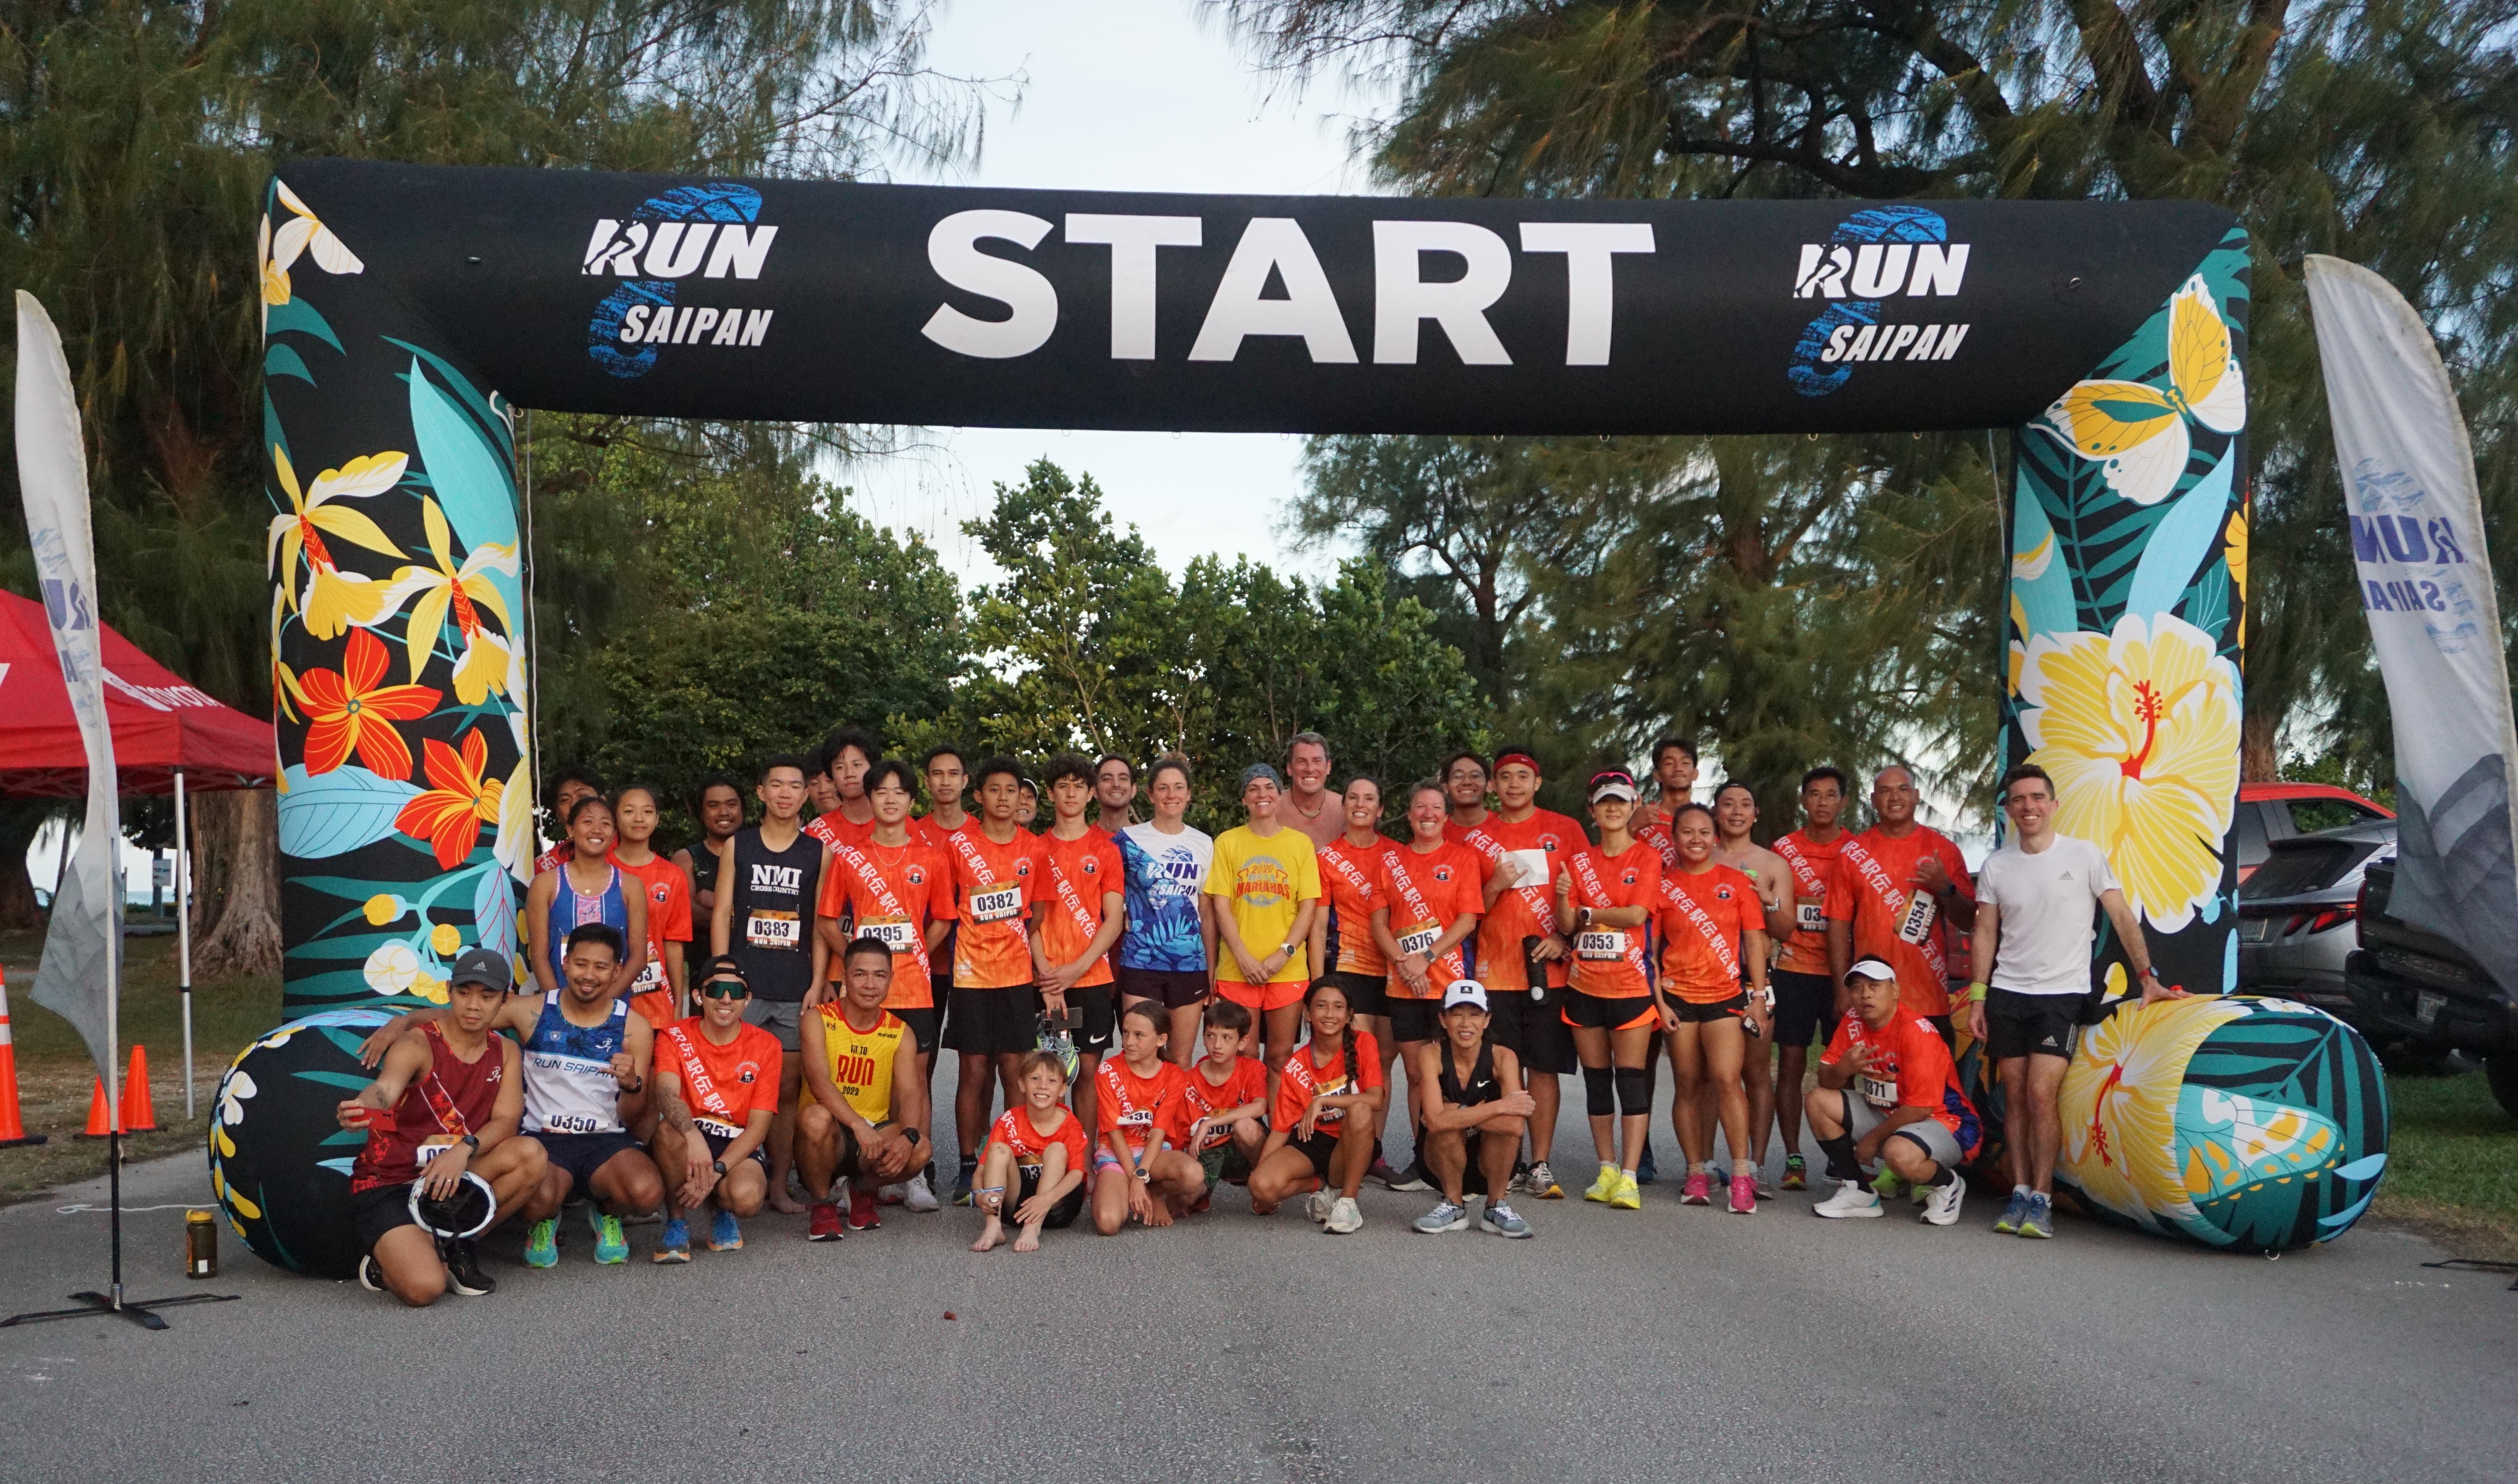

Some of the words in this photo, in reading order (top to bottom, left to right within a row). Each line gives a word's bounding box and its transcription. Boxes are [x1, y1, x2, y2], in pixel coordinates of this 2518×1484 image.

[581, 219, 778, 279] RUN
[1793, 243, 1970, 298] RUN
[921, 209, 1656, 366] START
[620, 305, 773, 347] SAIPAN
[1821, 324, 1969, 361] SAIPAN
[751, 864, 802, 889] NMI
[1146, 862, 1199, 880] RUN
[1251, 864, 1274, 874] 2020
[1158, 884, 1197, 896] SAIPAN
[1236, 881, 1290, 900] MARIANAS
[977, 892, 1014, 912] 0382
[995, 908, 1017, 918] SAIPAN
[1905, 900, 1928, 936] 0354
[754, 921, 789, 937] 0383
[863, 926, 902, 942] 0395
[1402, 932, 1434, 953] 0376
[1583, 934, 1614, 949] 0353
[634, 983, 656, 993] SAIPAN
[860, 1046, 867, 1056] TO
[533, 1058, 562, 1069] RUN
[836, 1054, 875, 1086] RUN
[551, 1115, 597, 1132] 0350
